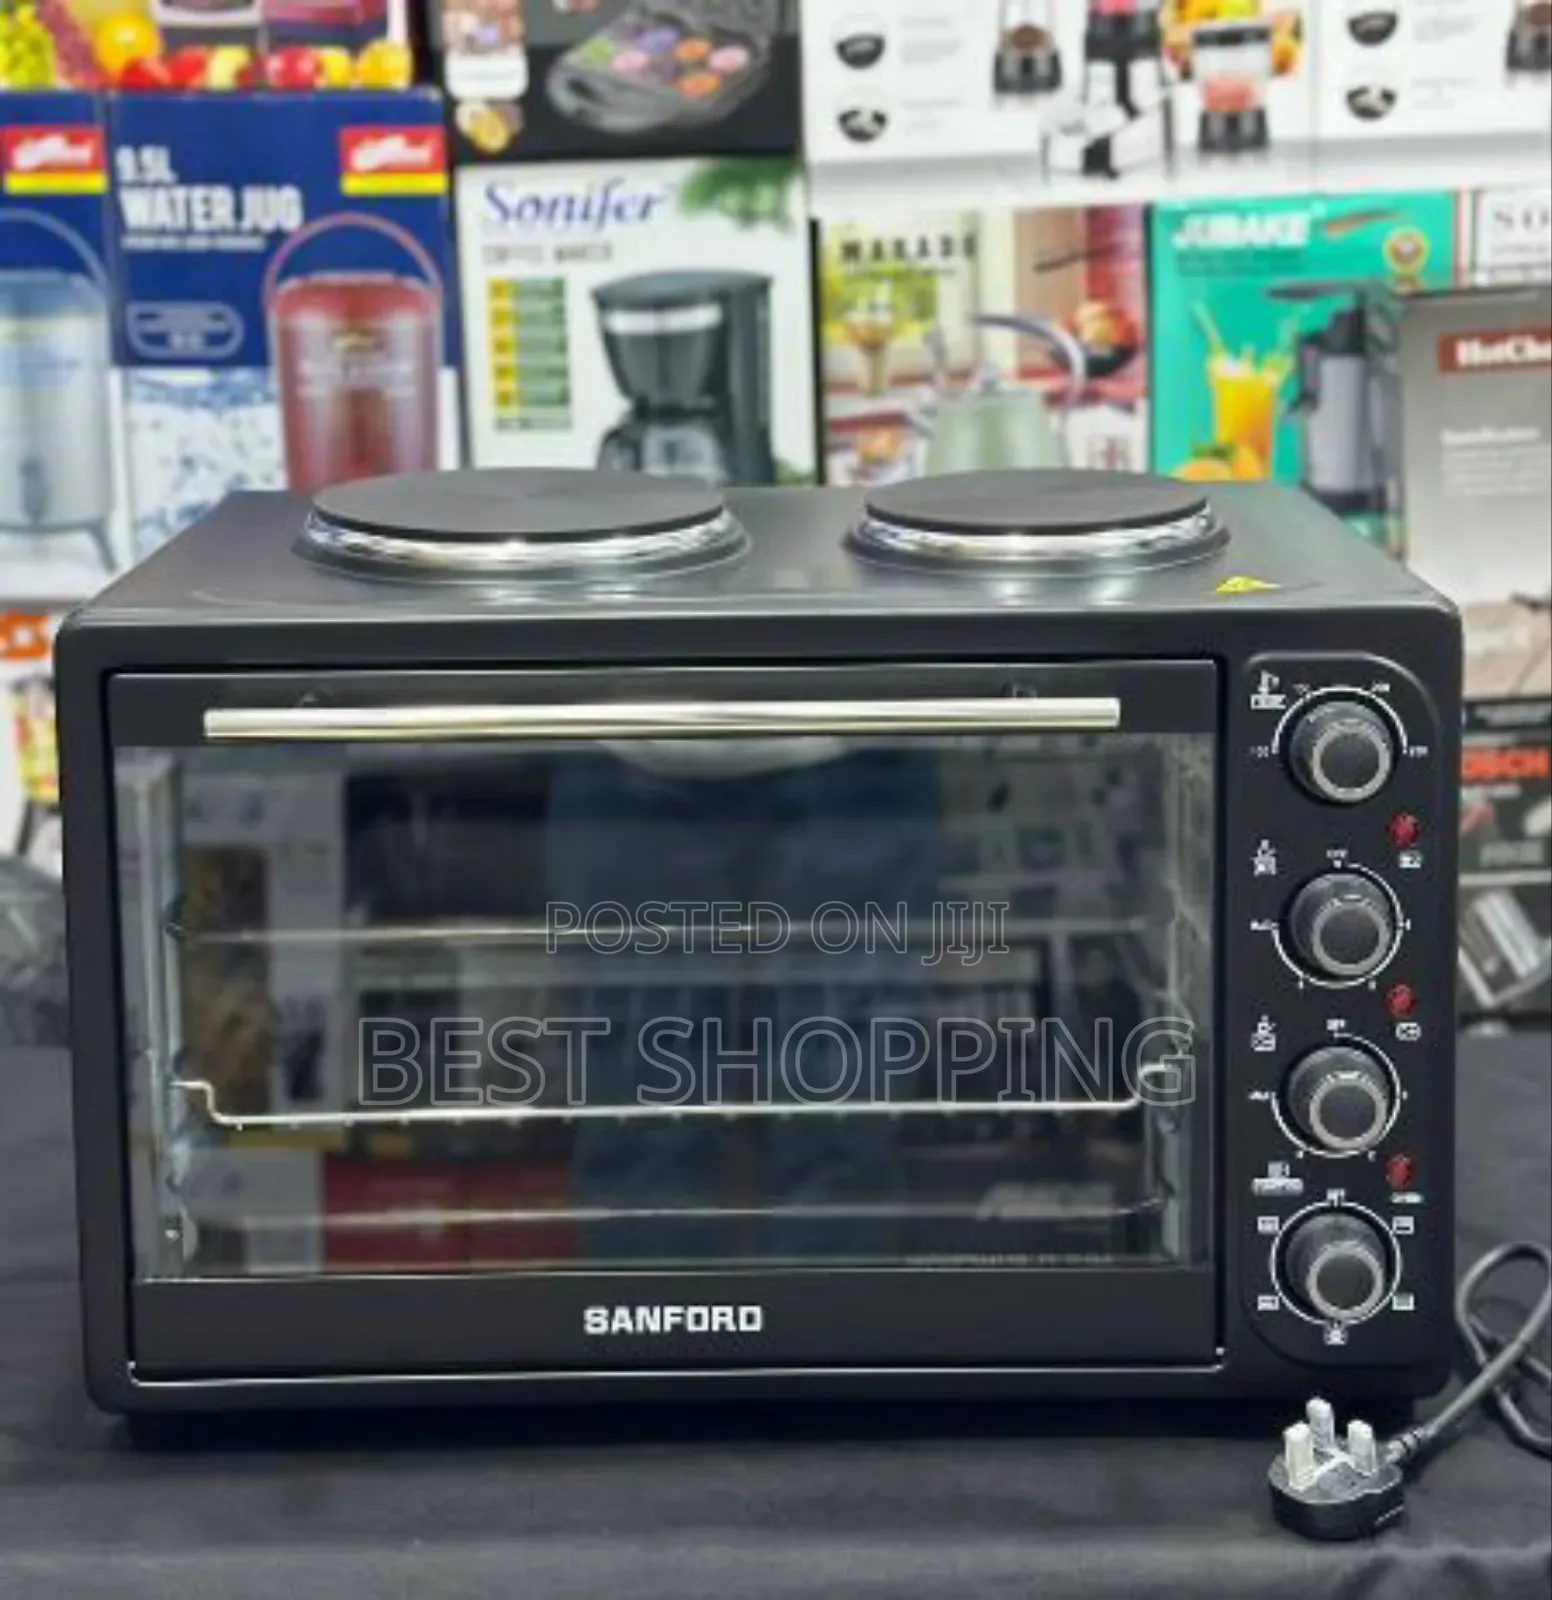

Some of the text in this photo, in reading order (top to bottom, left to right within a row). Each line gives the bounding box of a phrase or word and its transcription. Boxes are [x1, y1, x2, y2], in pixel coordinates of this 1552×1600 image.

[119, 184, 305, 234] WATER JUG
[482, 176, 666, 231] Sonifer
[1461, 747, 1550, 779] OSCH
[583, 1304, 764, 1335] SANFORD
